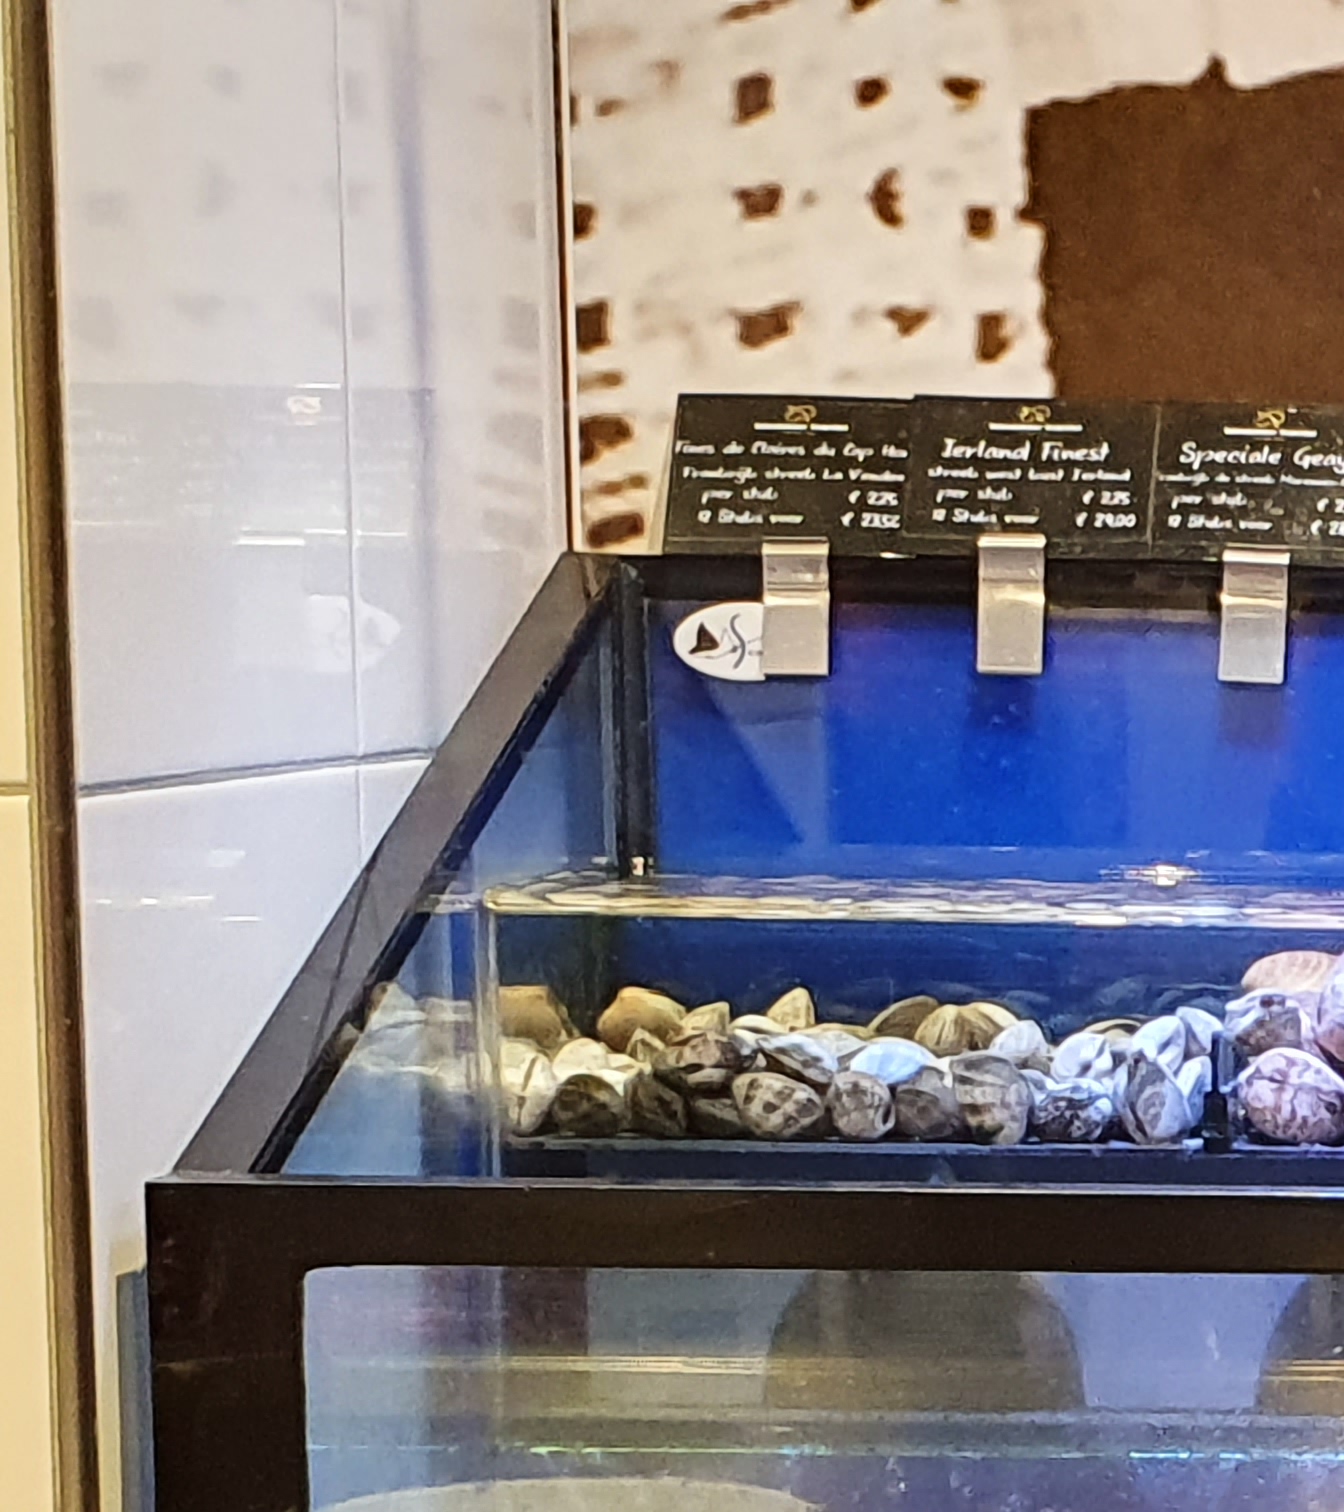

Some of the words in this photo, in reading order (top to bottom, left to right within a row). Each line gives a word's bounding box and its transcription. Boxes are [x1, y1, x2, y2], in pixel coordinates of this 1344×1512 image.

[941, 437, 1030, 462] Ierland
[1041, 441, 1110, 462] Finest
[1179, 441, 1282, 470] Speciale
